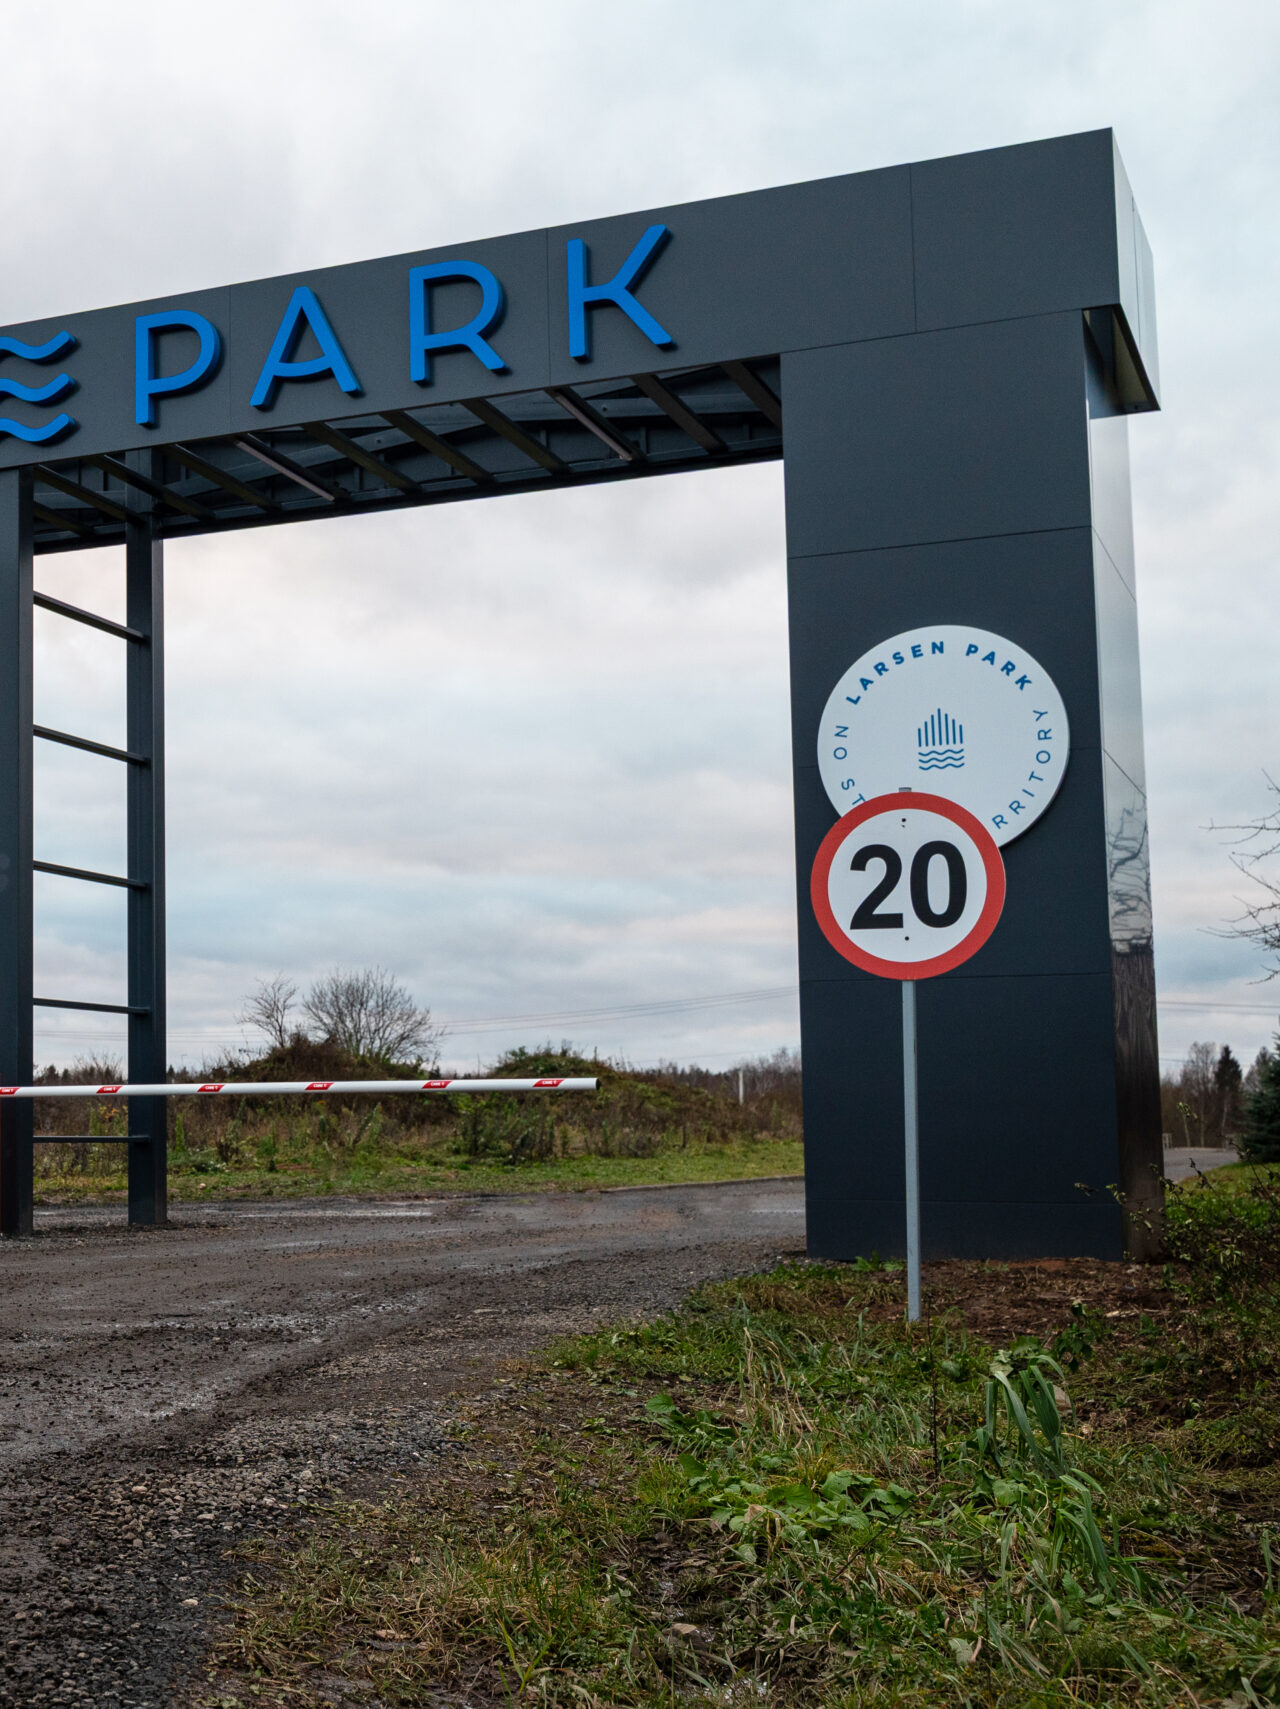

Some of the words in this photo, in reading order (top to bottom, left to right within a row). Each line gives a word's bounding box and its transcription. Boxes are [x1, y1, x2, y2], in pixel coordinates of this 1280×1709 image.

[134, 223, 674, 427] PARK
[845, 640, 945, 706] LARSEN
[965, 643, 1033, 691] PARK
[991, 709, 1053, 830] RRITORY
[849, 840, 968, 930] 20
